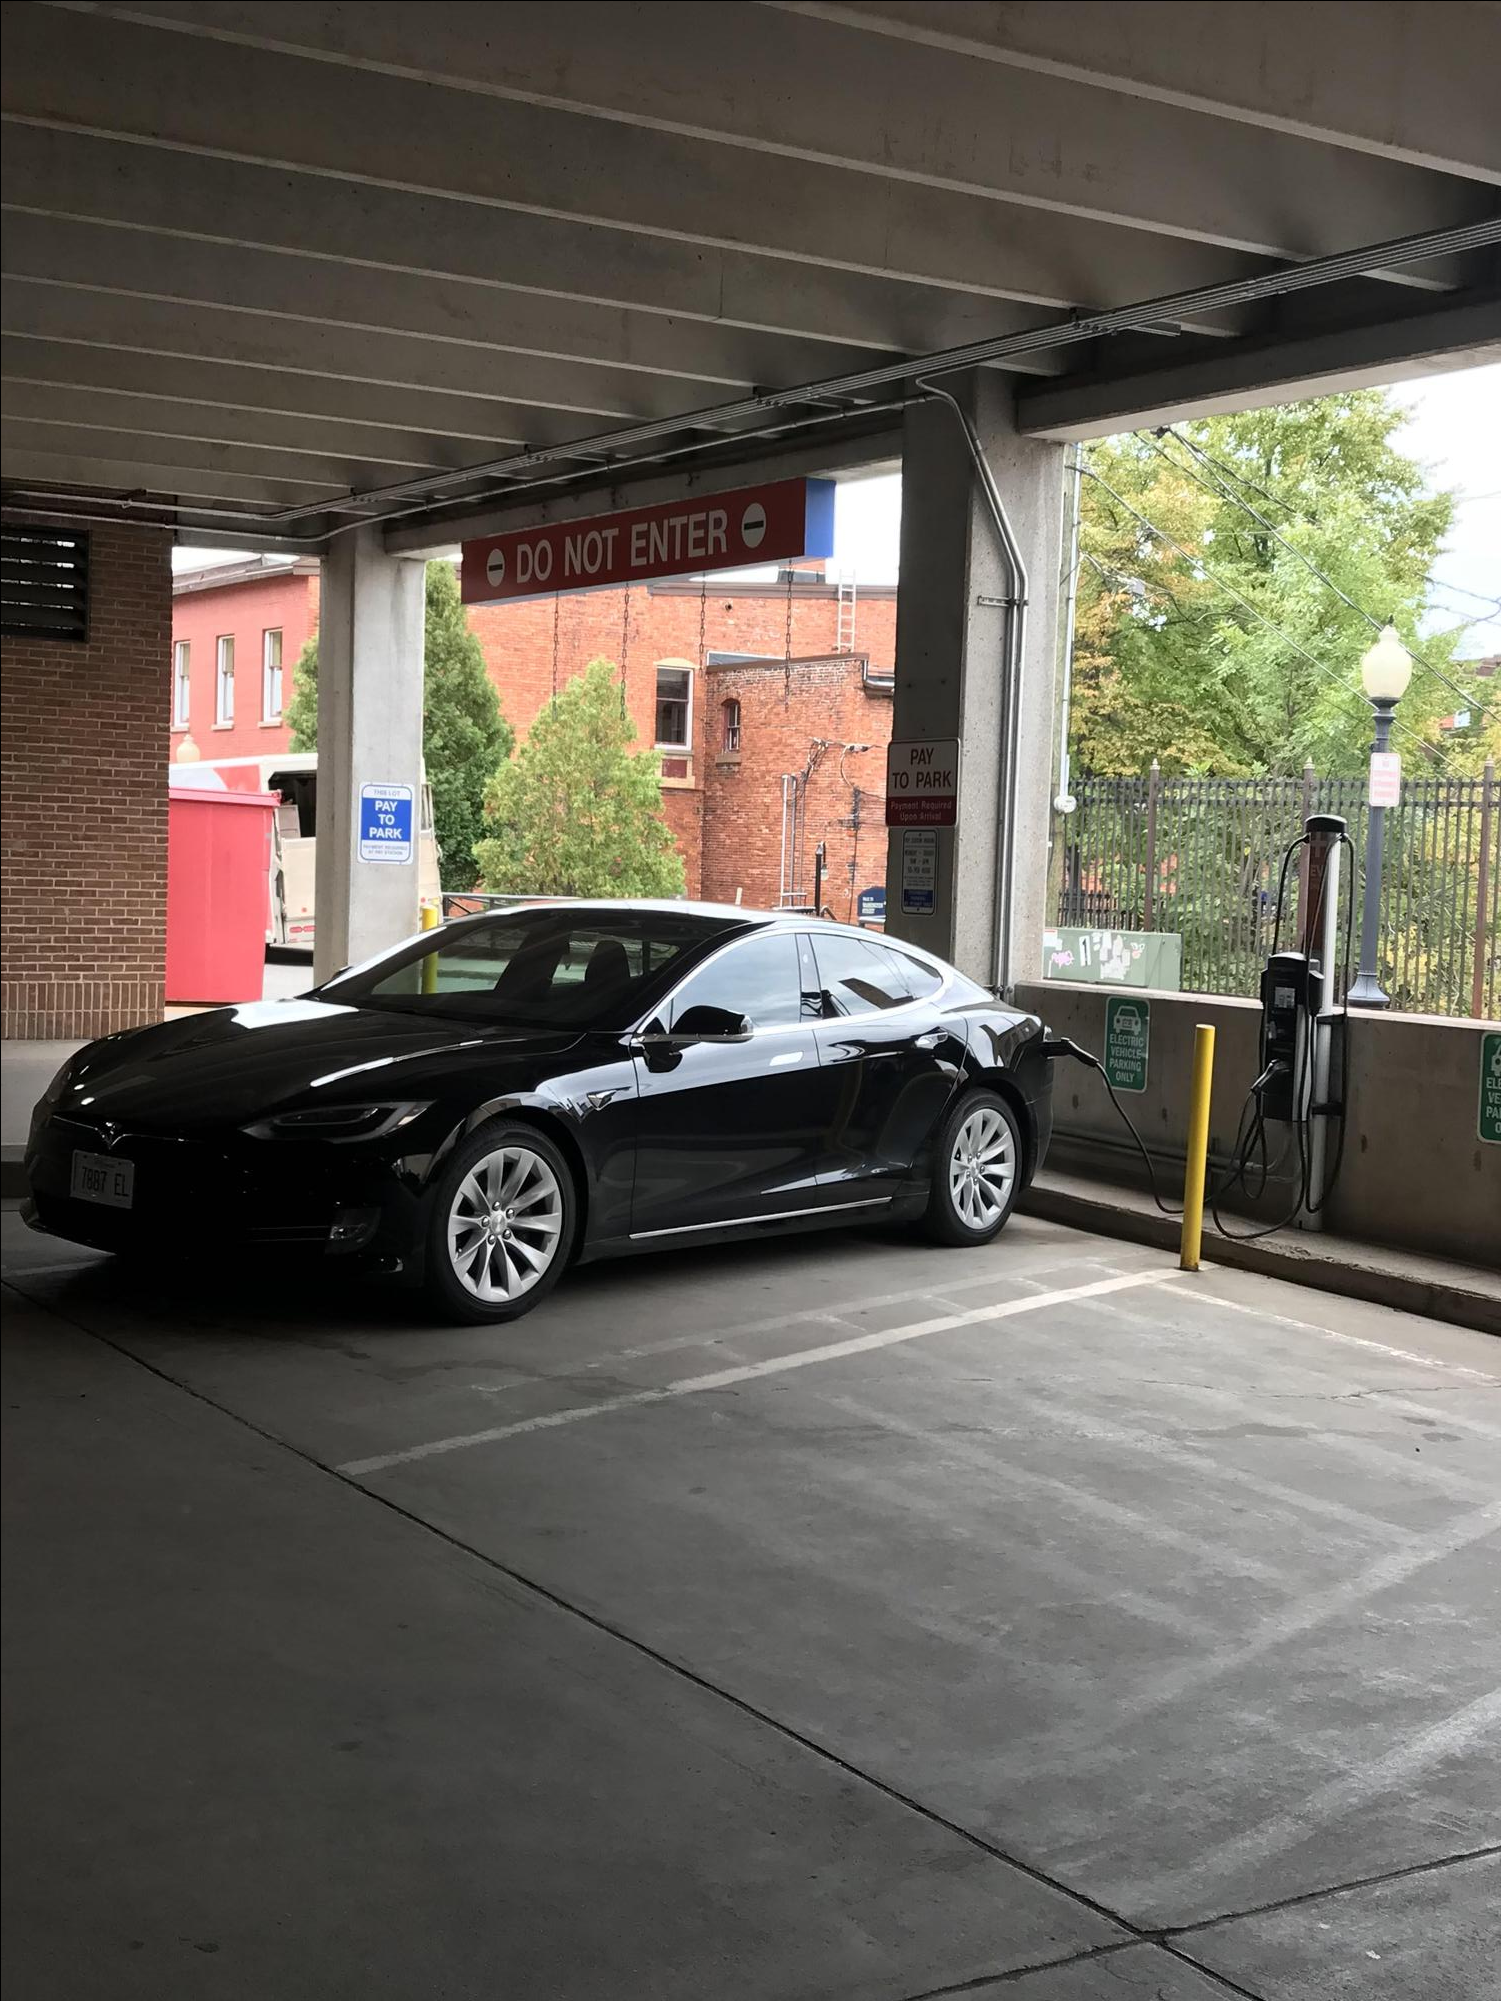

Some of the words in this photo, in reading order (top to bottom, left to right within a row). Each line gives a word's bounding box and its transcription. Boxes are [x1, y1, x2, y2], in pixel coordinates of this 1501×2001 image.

[517, 540, 552, 583] DO
[564, 528, 619, 577] NOT
[630, 509, 728, 567] ENTER
[910, 748, 934, 766] PAY
[892, 771, 909, 789] TO
[916, 770, 952, 788] PARK
[374, 800, 398, 812] PAY
[921, 800, 952, 810] Required
[378, 814, 395, 826] TO
[369, 827, 403, 839] PARK
[1109, 1034, 1144, 1047] ELECTRIC
[1110, 1046, 1142, 1059] VEHICLE
[1109, 1059, 1141, 1072] PARKING
[1115, 1071, 1135, 1083] ONLY
[82, 1166, 107, 1193] 7887
[114, 1173, 130, 1197] EL
